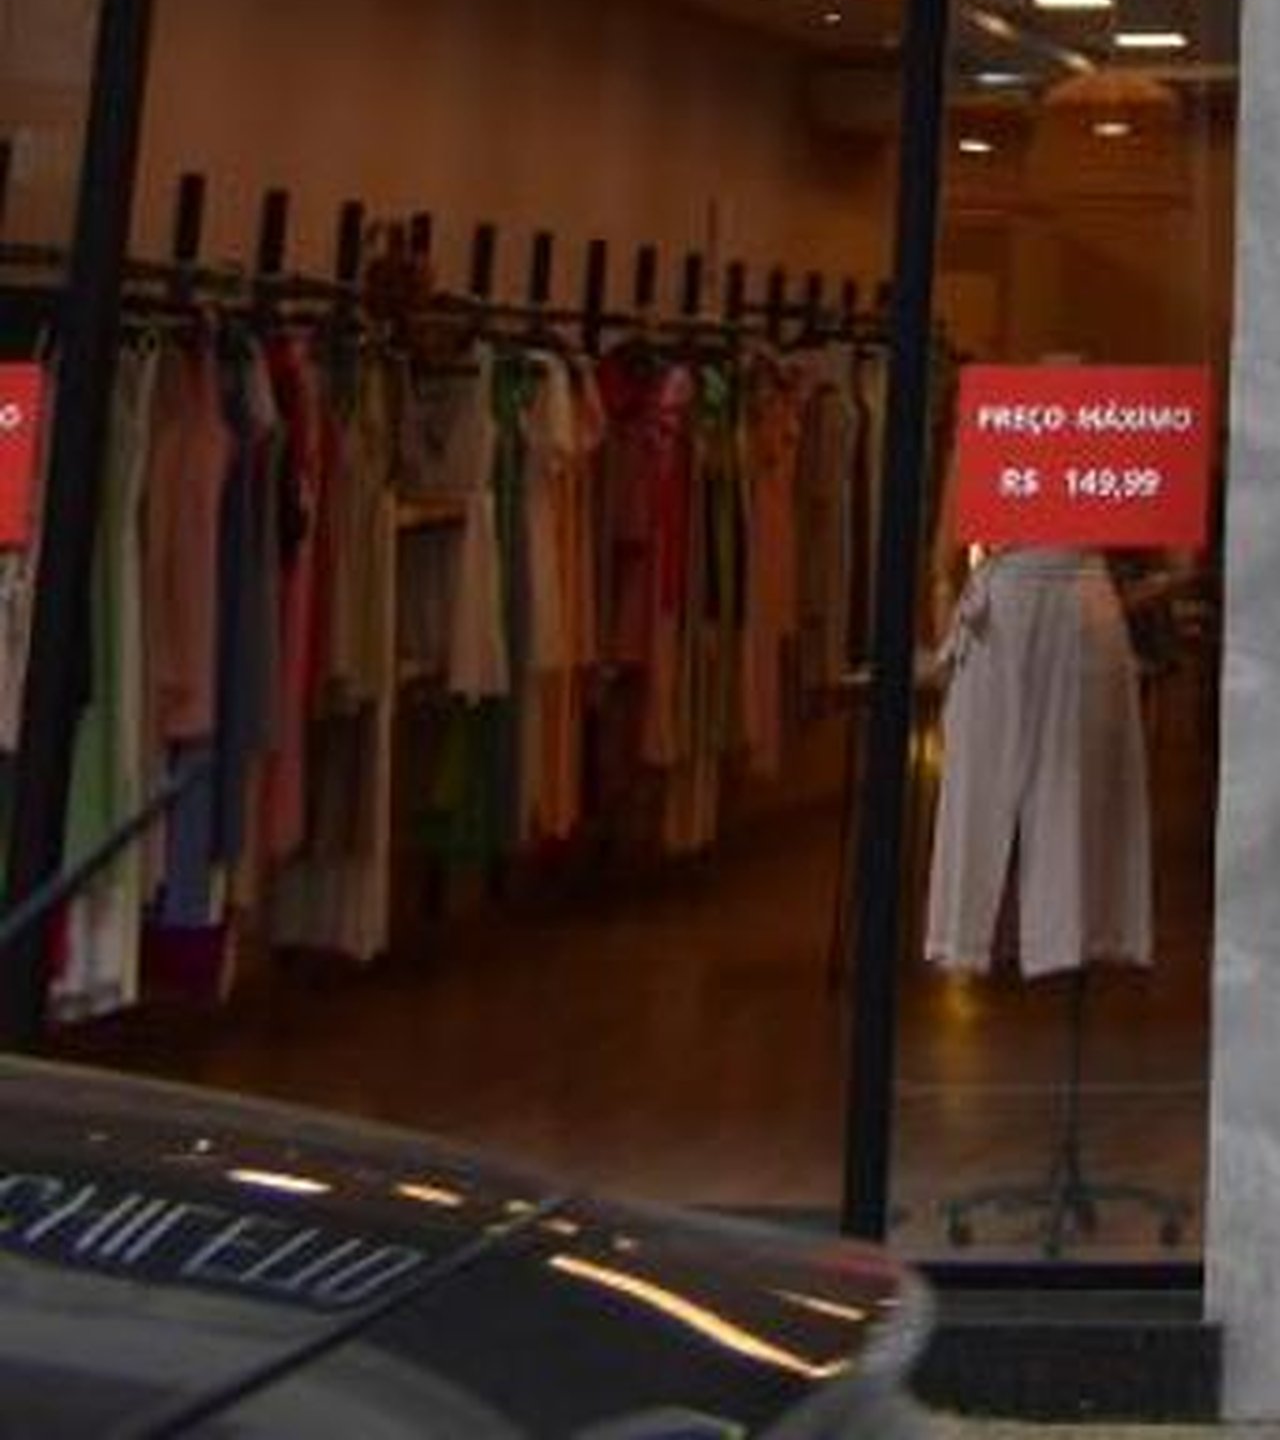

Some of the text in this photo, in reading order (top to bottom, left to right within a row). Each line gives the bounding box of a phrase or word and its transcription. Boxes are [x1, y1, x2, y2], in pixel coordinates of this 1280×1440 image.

[977, 400, 1192, 434] PREÇO MÁXIMO
[1000, 467, 1040, 498] R$
